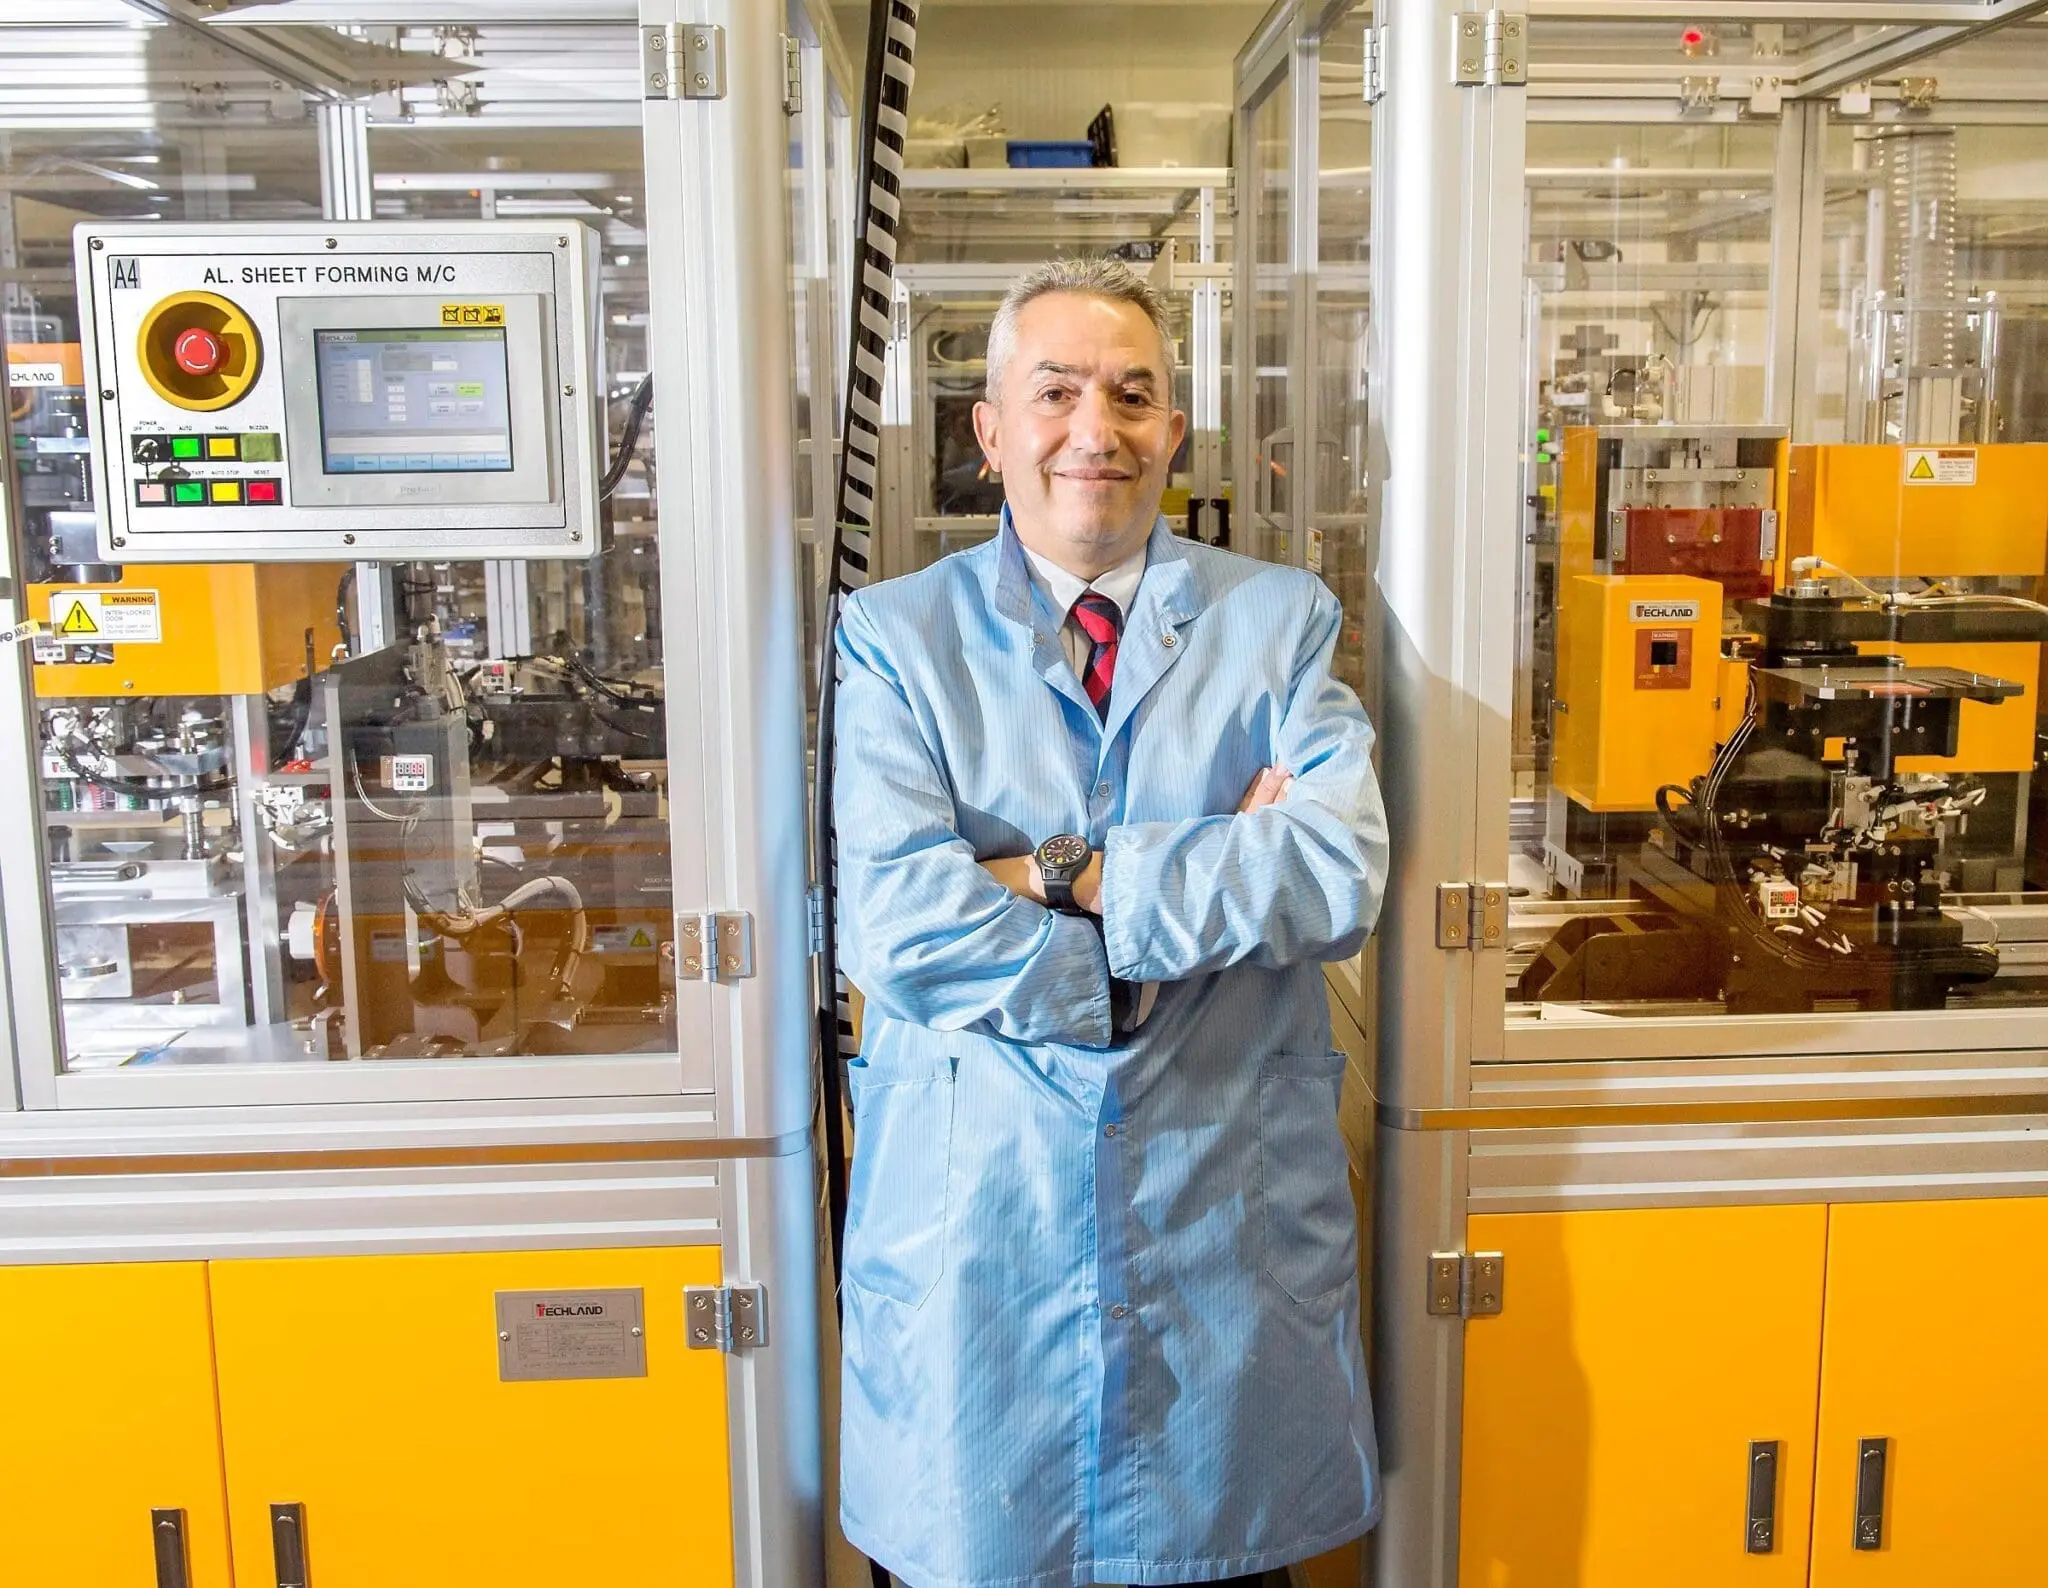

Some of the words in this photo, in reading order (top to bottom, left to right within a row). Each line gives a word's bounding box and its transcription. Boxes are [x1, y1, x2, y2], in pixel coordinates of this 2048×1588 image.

[114, 259, 138, 289] A4
[203, 267, 233, 283] AL.
[241, 266, 307, 283] SHEET
[315, 266, 408, 283] FORMING
[417, 265, 456, 283] M/C
[1636, 605, 1693, 617] TECHLAND
[536, 1304, 603, 1317] TECHLAND
